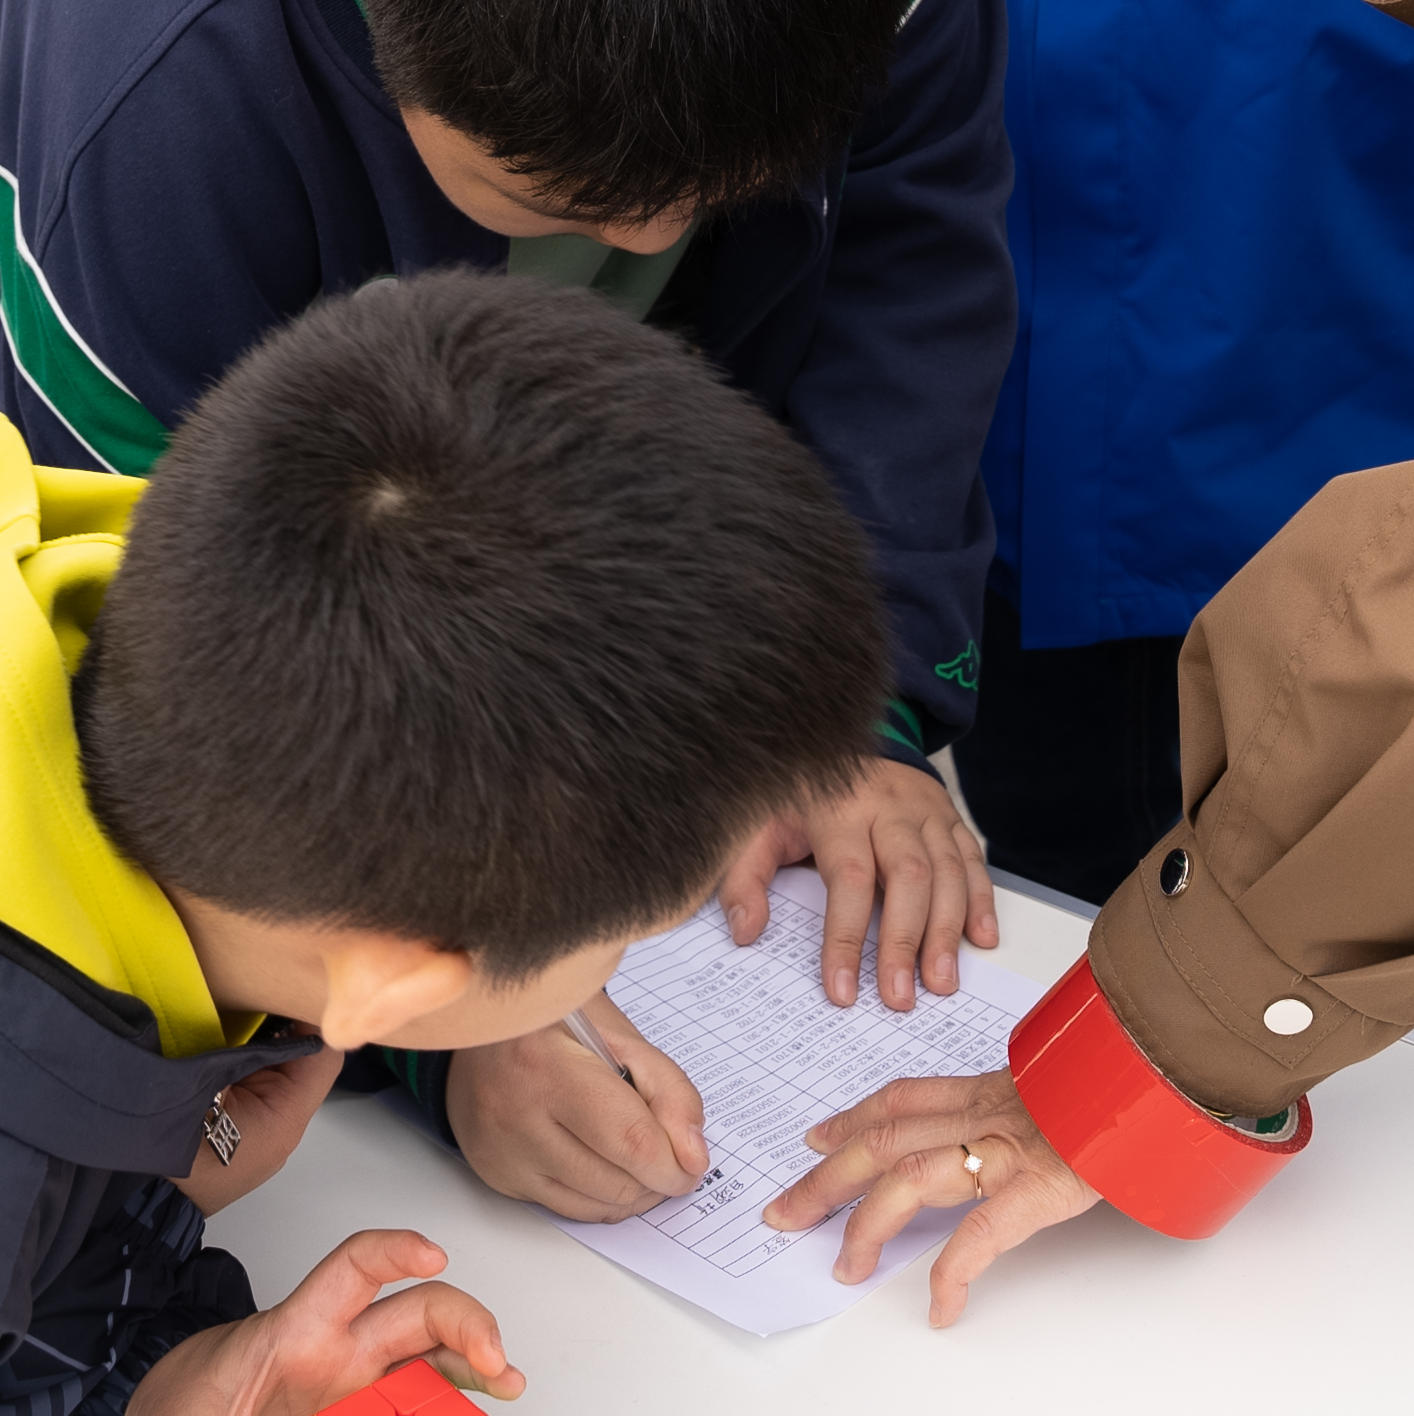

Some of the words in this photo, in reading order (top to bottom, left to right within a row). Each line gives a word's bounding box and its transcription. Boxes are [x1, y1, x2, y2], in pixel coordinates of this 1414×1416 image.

[776, 908, 789, 917] 17
[790, 915, 804, 924] 16
[805, 923, 819, 932] 15
[815, 1036, 870, 1072] 山水2-2401
[831, 1045, 887, 1081] 山水2-2401
[719, 1094, 780, 1128] 13503536228
[735, 1104, 796, 1138] 13503536228
